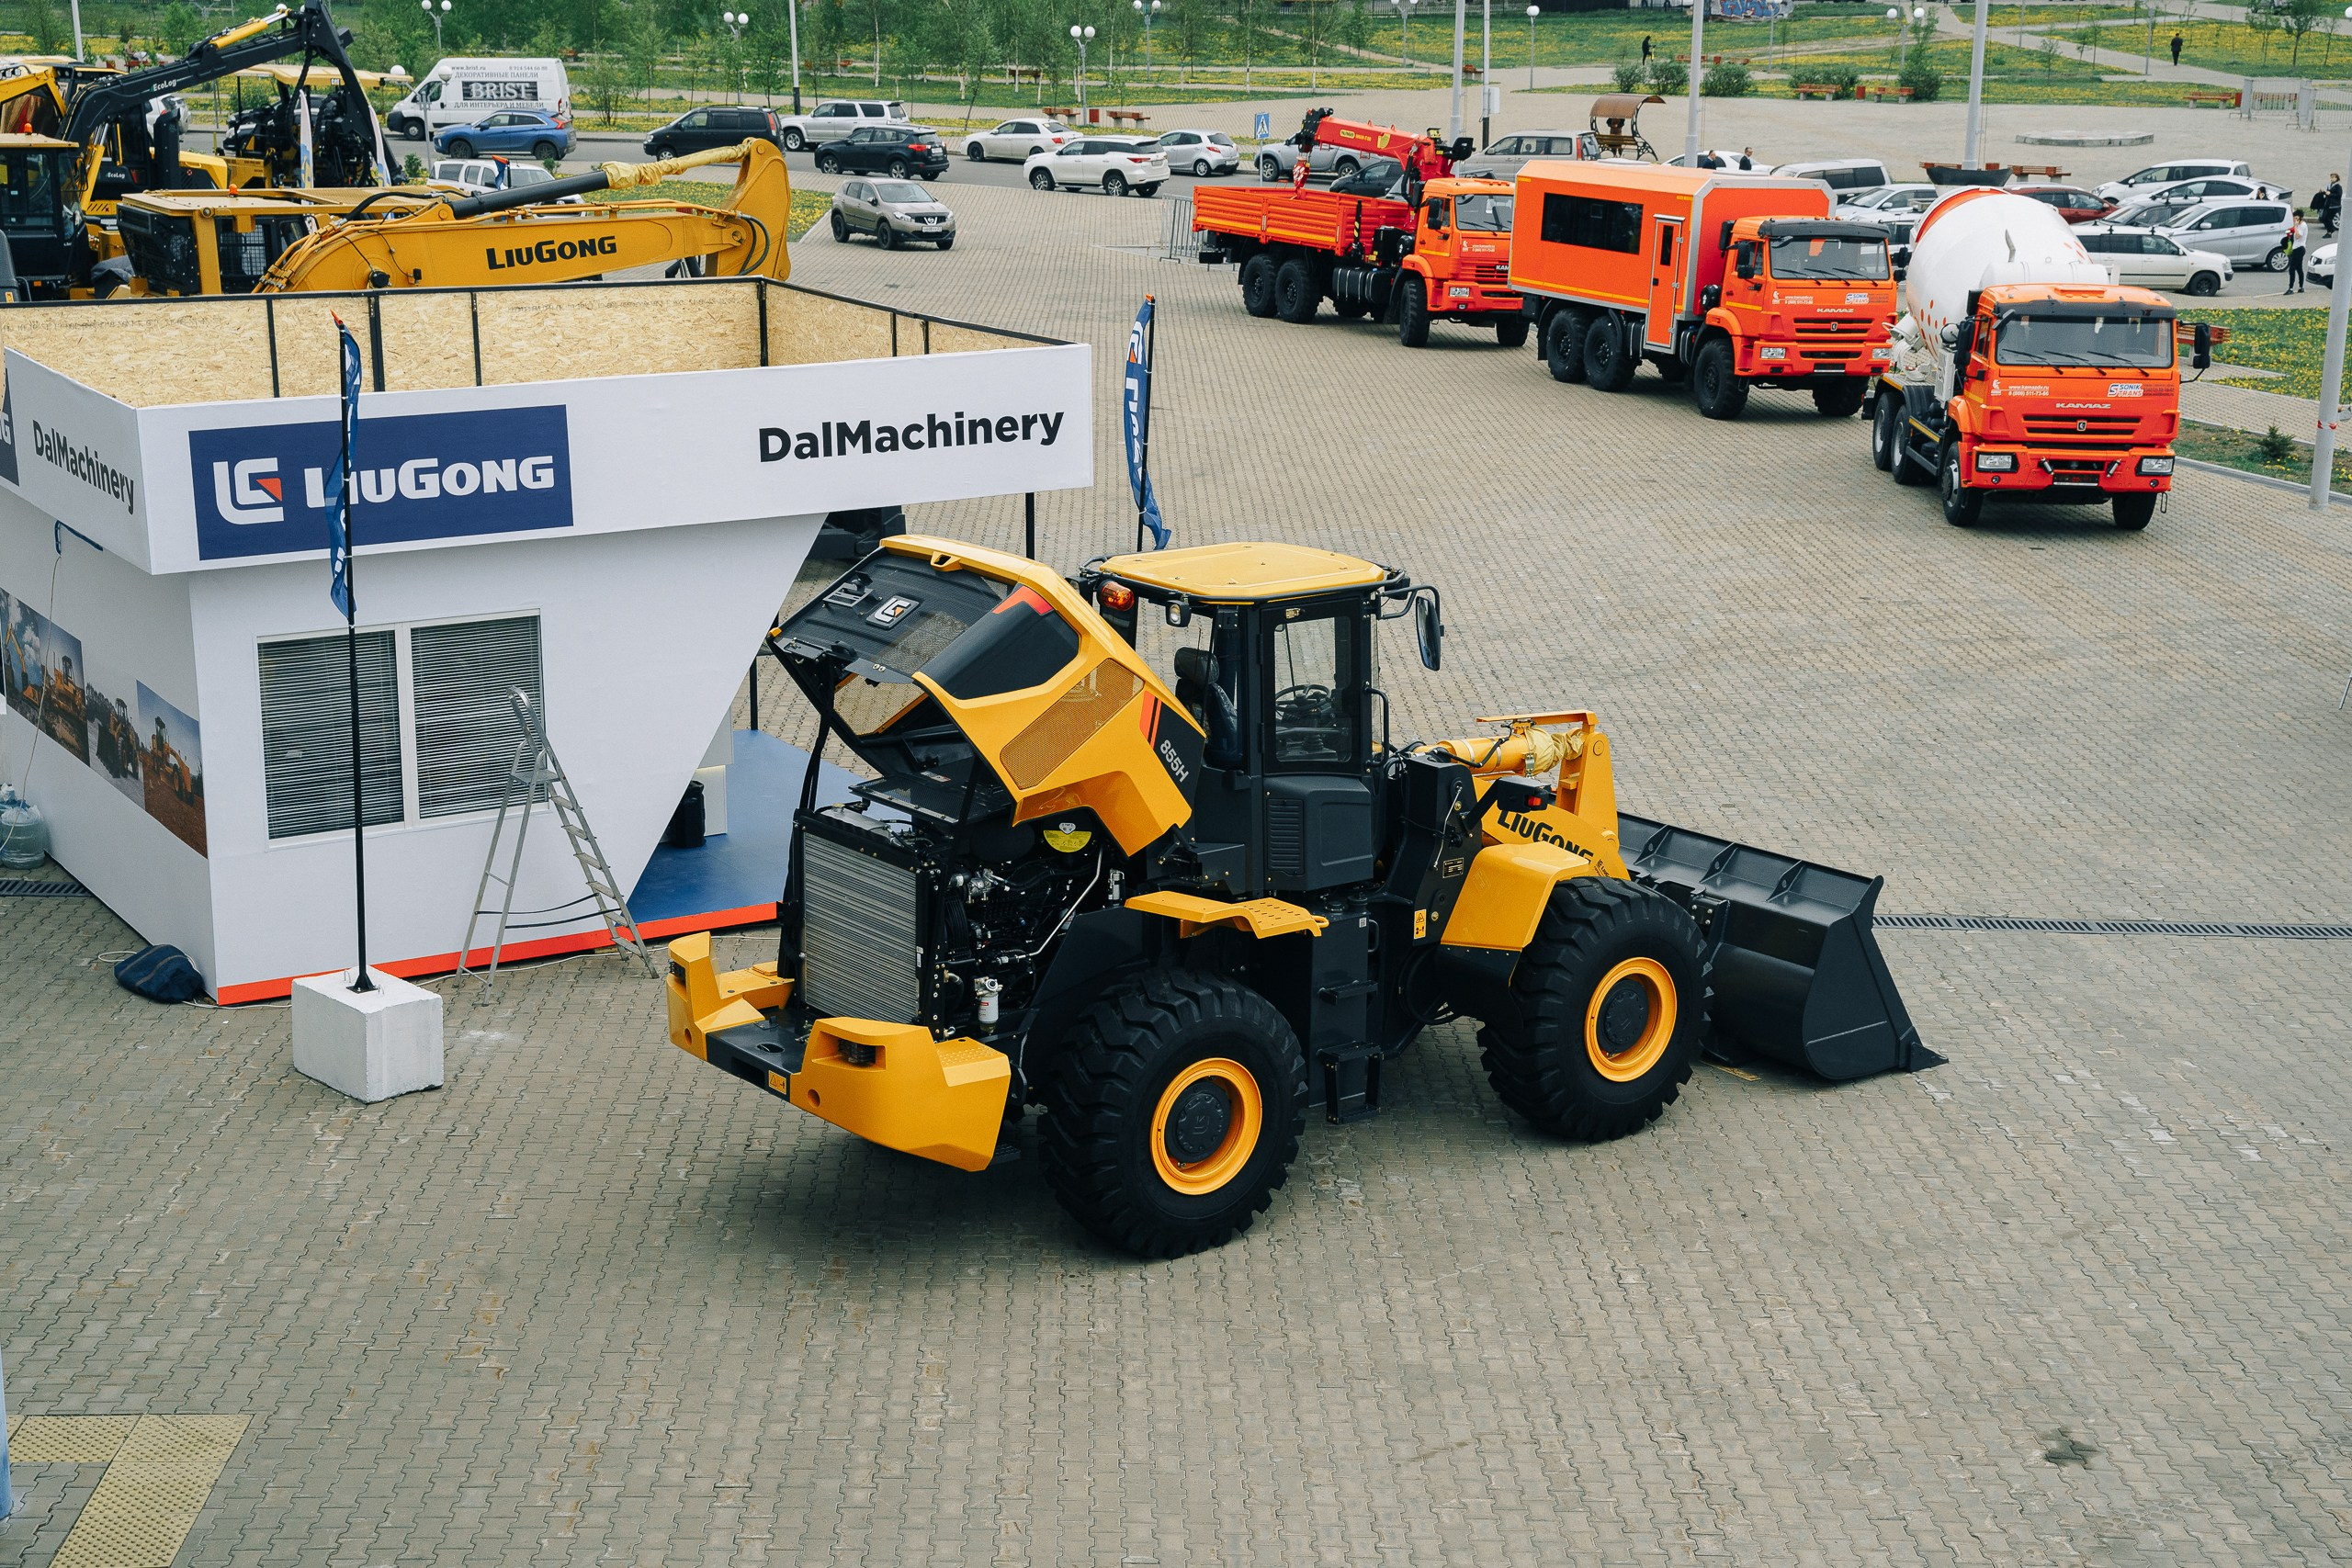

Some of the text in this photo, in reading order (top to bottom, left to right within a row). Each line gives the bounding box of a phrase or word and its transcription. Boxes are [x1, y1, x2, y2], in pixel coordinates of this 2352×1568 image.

[153, 79, 176, 92] EcoLog
[469, 82, 530, 100] BRIST
[486, 235, 617, 270] LIUGONG
[759, 411, 1065, 462] DalMachinery
[33, 419, 134, 515] DalMachinery
[1160, 739, 1190, 783] 855H
